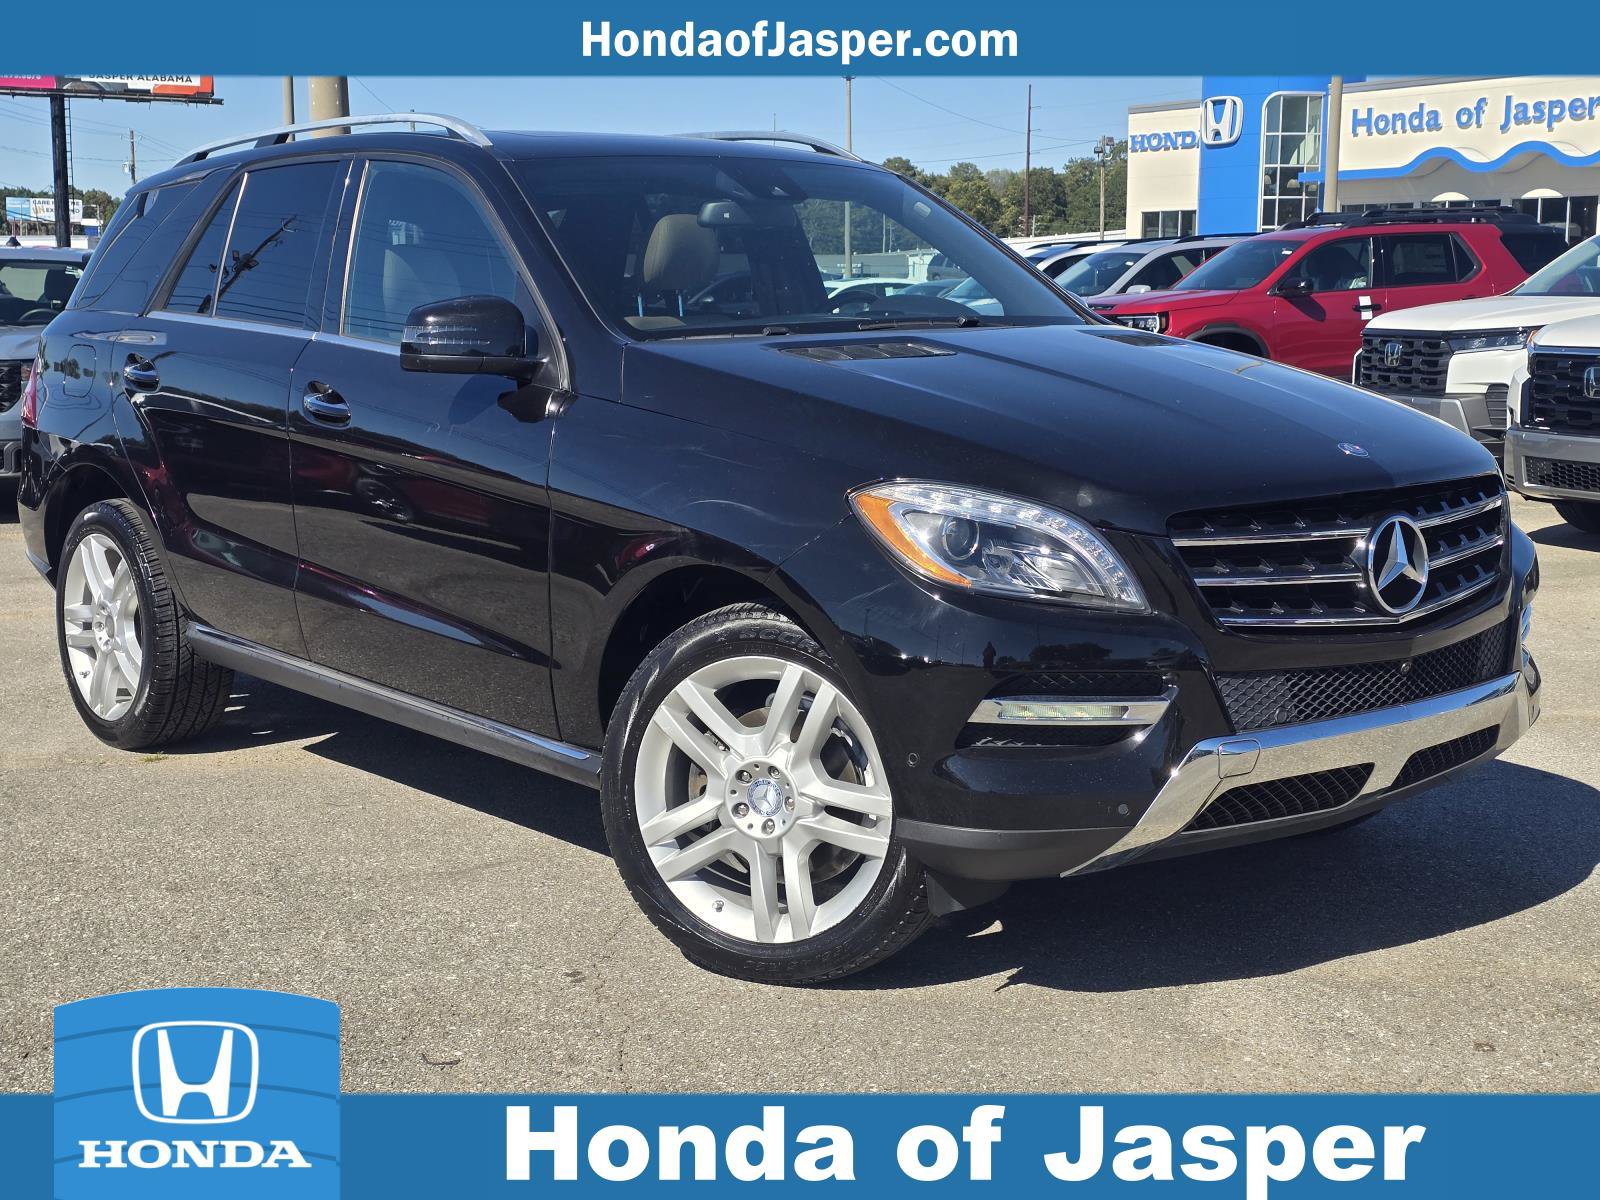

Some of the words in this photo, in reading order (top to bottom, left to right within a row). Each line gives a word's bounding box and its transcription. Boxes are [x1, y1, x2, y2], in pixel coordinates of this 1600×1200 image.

[137, 74, 192, 83] ALABAMA
[1352, 103, 1442, 137] Honda
[1456, 97, 1488, 129] of
[1500, 95, 1600, 133] Jasper
[1129, 130, 1201, 152] HOND
